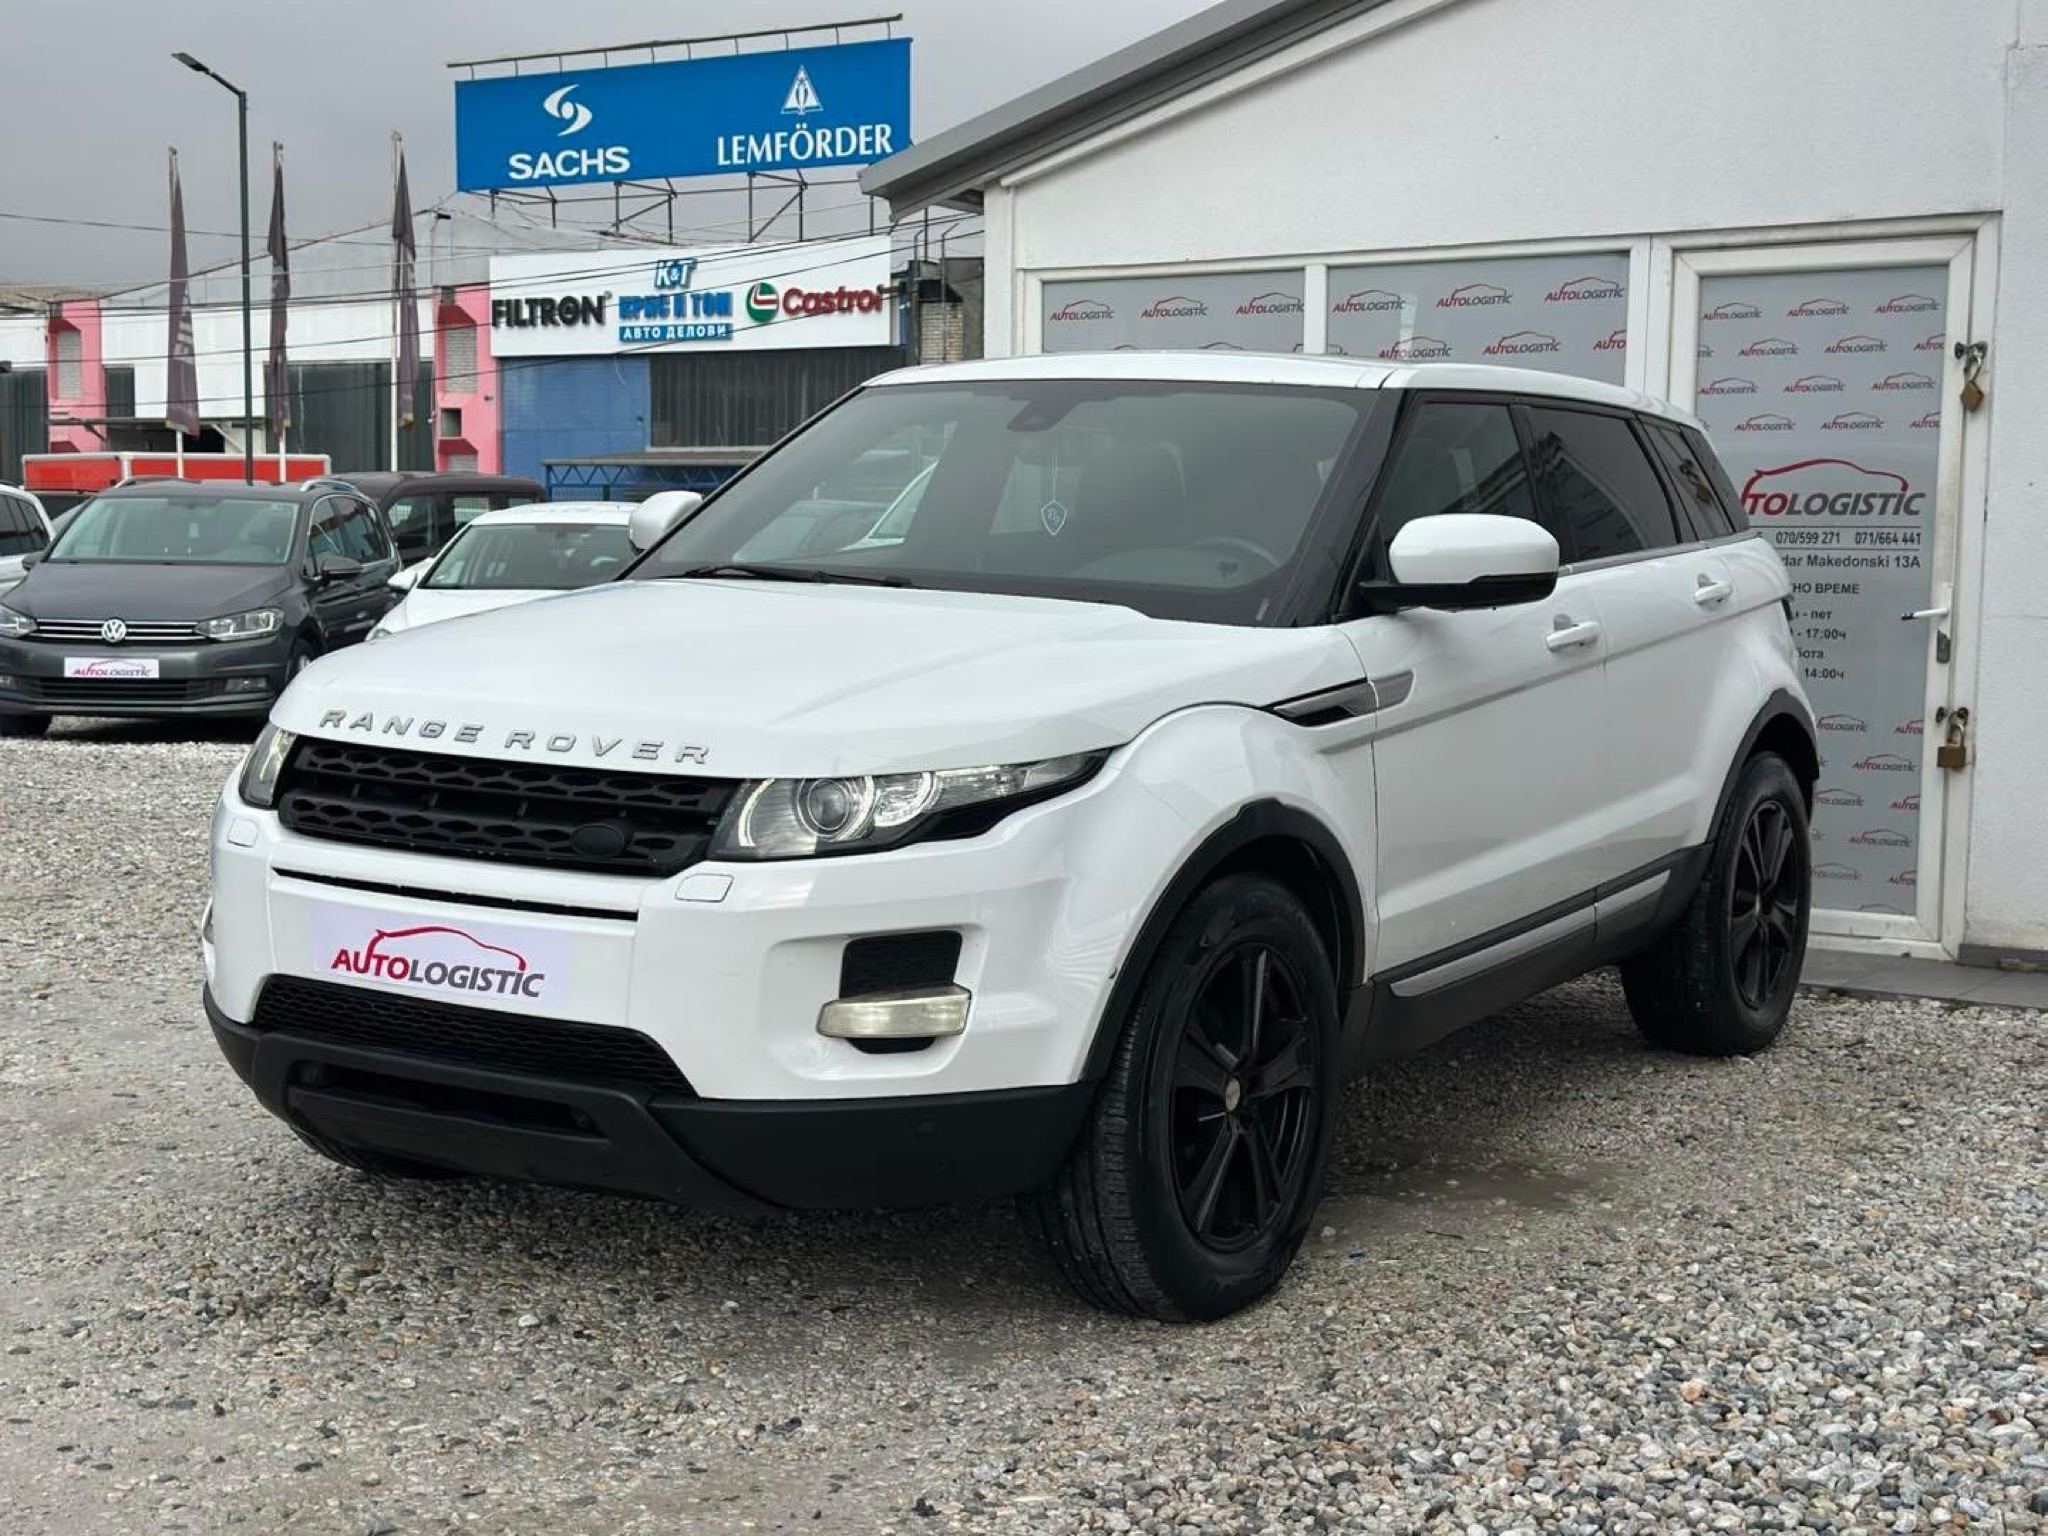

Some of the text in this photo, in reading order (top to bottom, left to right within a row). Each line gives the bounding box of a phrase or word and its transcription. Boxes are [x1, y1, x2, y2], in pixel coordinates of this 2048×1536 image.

[717, 121, 894, 166] LEMFÖRDER
[508, 145, 632, 180] SACHS
[655, 258, 695, 289] K&T
[1436, 293, 1512, 308] AUTOLOGISTIC
[1545, 287, 1625, 302] AUTOLOGISTIC
[1141, 305, 1208, 319] AUTOLOGISTIC
[1332, 299, 1405, 313] AUTOLOGISTIC
[1875, 303, 1941, 315] AUTOLOGISTIC
[1050, 309, 1115, 321] AUTOLOGISTIC
[622, 324, 728, 340] АВТО ДЕЛОВИ
[1483, 342, 1560, 355] AUTOLOGISTIC
[1741, 491, 1926, 517] TOLOGISTIC
[1775, 531, 1819, 545] 070/599
[1821, 531, 1841, 545] 271
[1854, 531, 1899, 546] 071/664
[1901, 531, 1922, 546] 441
[1806, 555, 1890, 569] Makedonski
[1895, 555, 1921, 569] 13A
[1815, 582, 1861, 595] ВРЕМЕ
[1811, 610, 1833, 620] пет
[319, 708, 711, 765] RANGE ROVER
[330, 948, 546, 998] AUTOLOGISTIC
